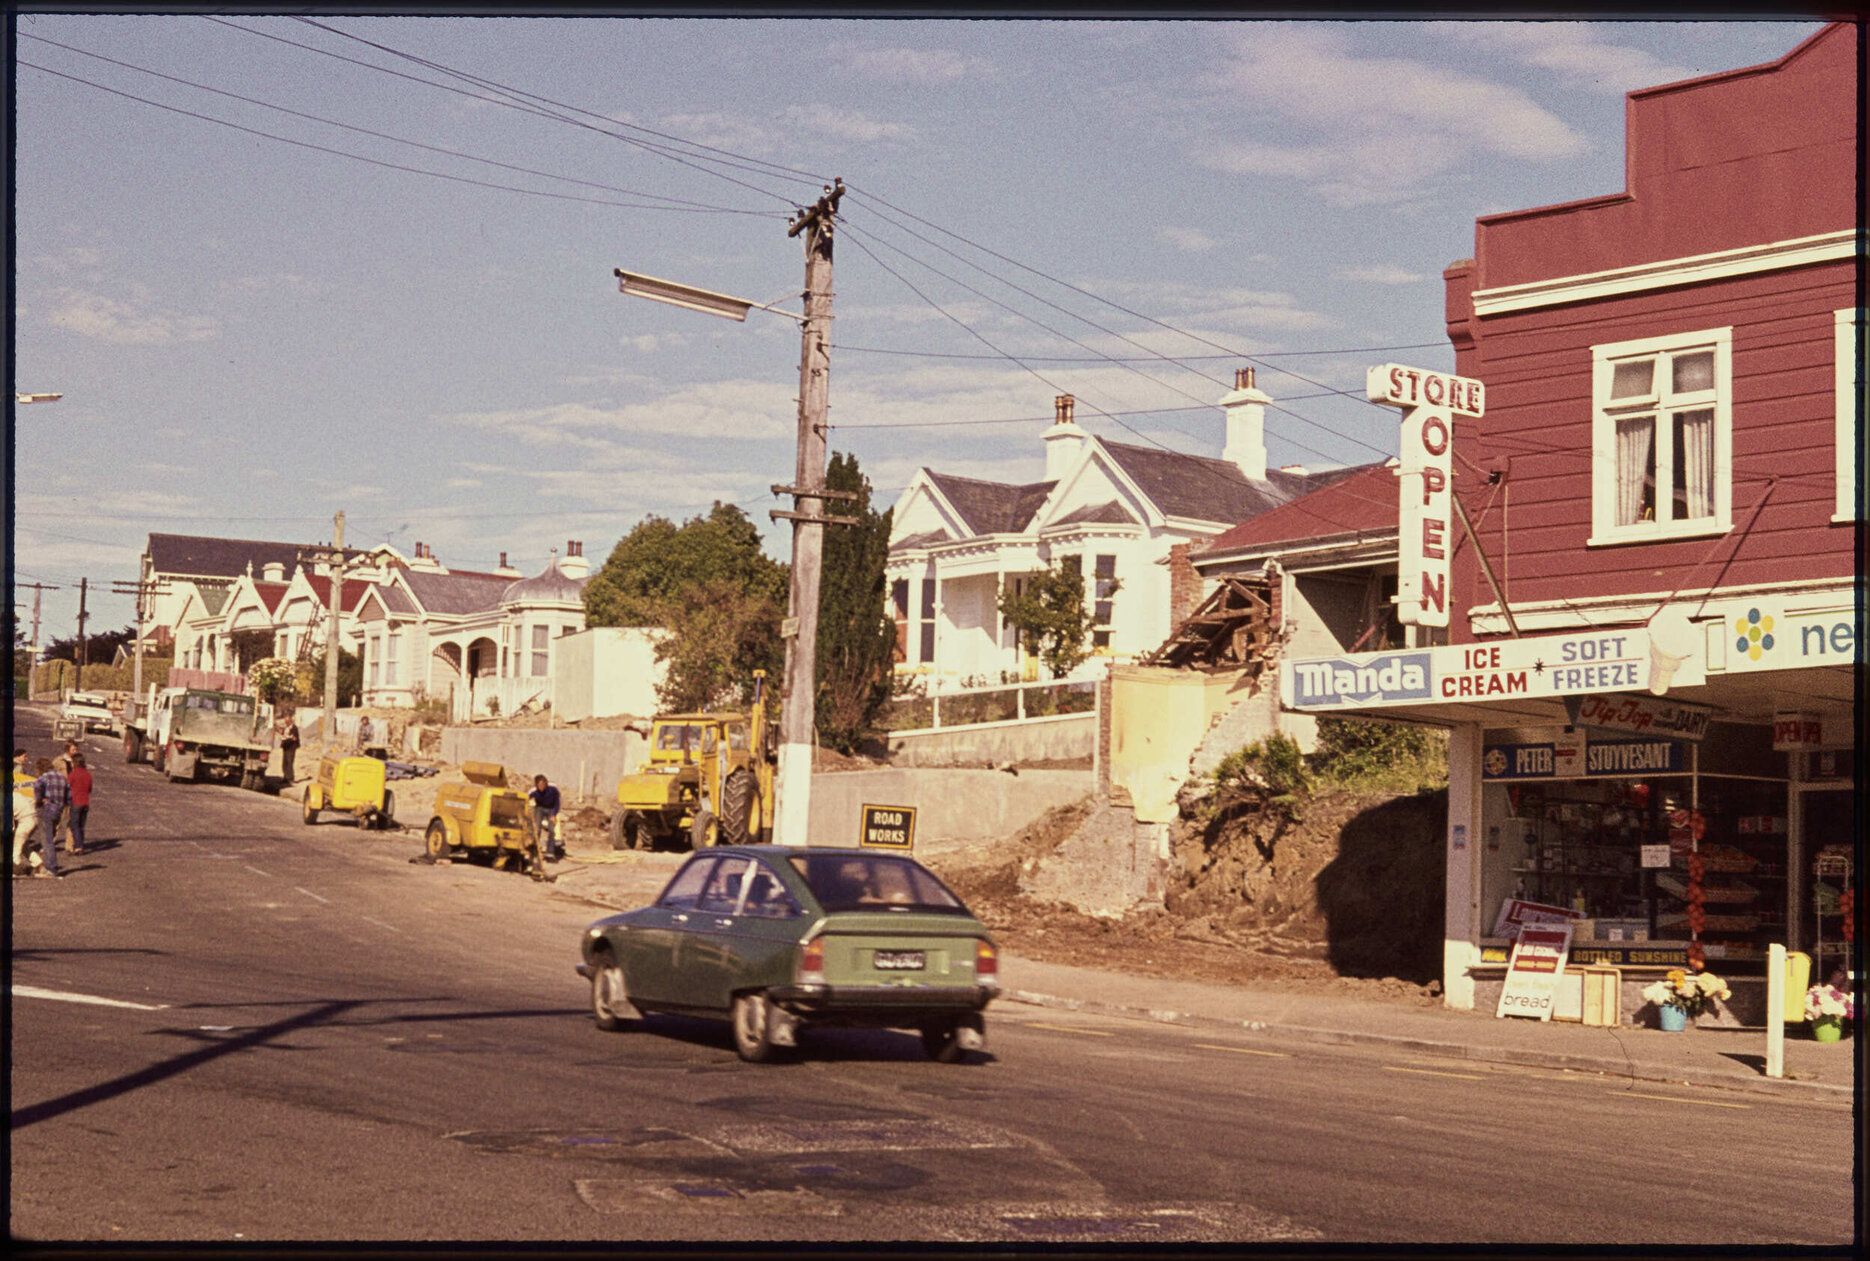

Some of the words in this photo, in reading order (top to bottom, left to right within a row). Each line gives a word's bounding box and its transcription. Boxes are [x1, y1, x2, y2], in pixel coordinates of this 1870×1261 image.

[1390, 368, 1480, 413] STORE
[1420, 416, 1449, 613] OPEN
[1465, 647, 1500, 670] ICE
[1562, 637, 1627, 662] SOFT
[1295, 658, 1425, 697] Manda
[1441, 671, 1528, 698] CREAM
[1553, 664, 1639, 690] FREEZE
[1581, 694, 1617, 725] Tip
[1617, 700, 1653, 731] Top
[1516, 748, 1553, 774] PETER
[1589, 742, 1672, 771] STUYVESANT
[874, 811, 903, 826] ROAD
[869, 828, 905, 843] WORKS
[1573, 950, 1623, 963] BOTTLED
[1629, 950, 1687, 963] SUNSHINE
[1504, 991, 1552, 1009] bread
